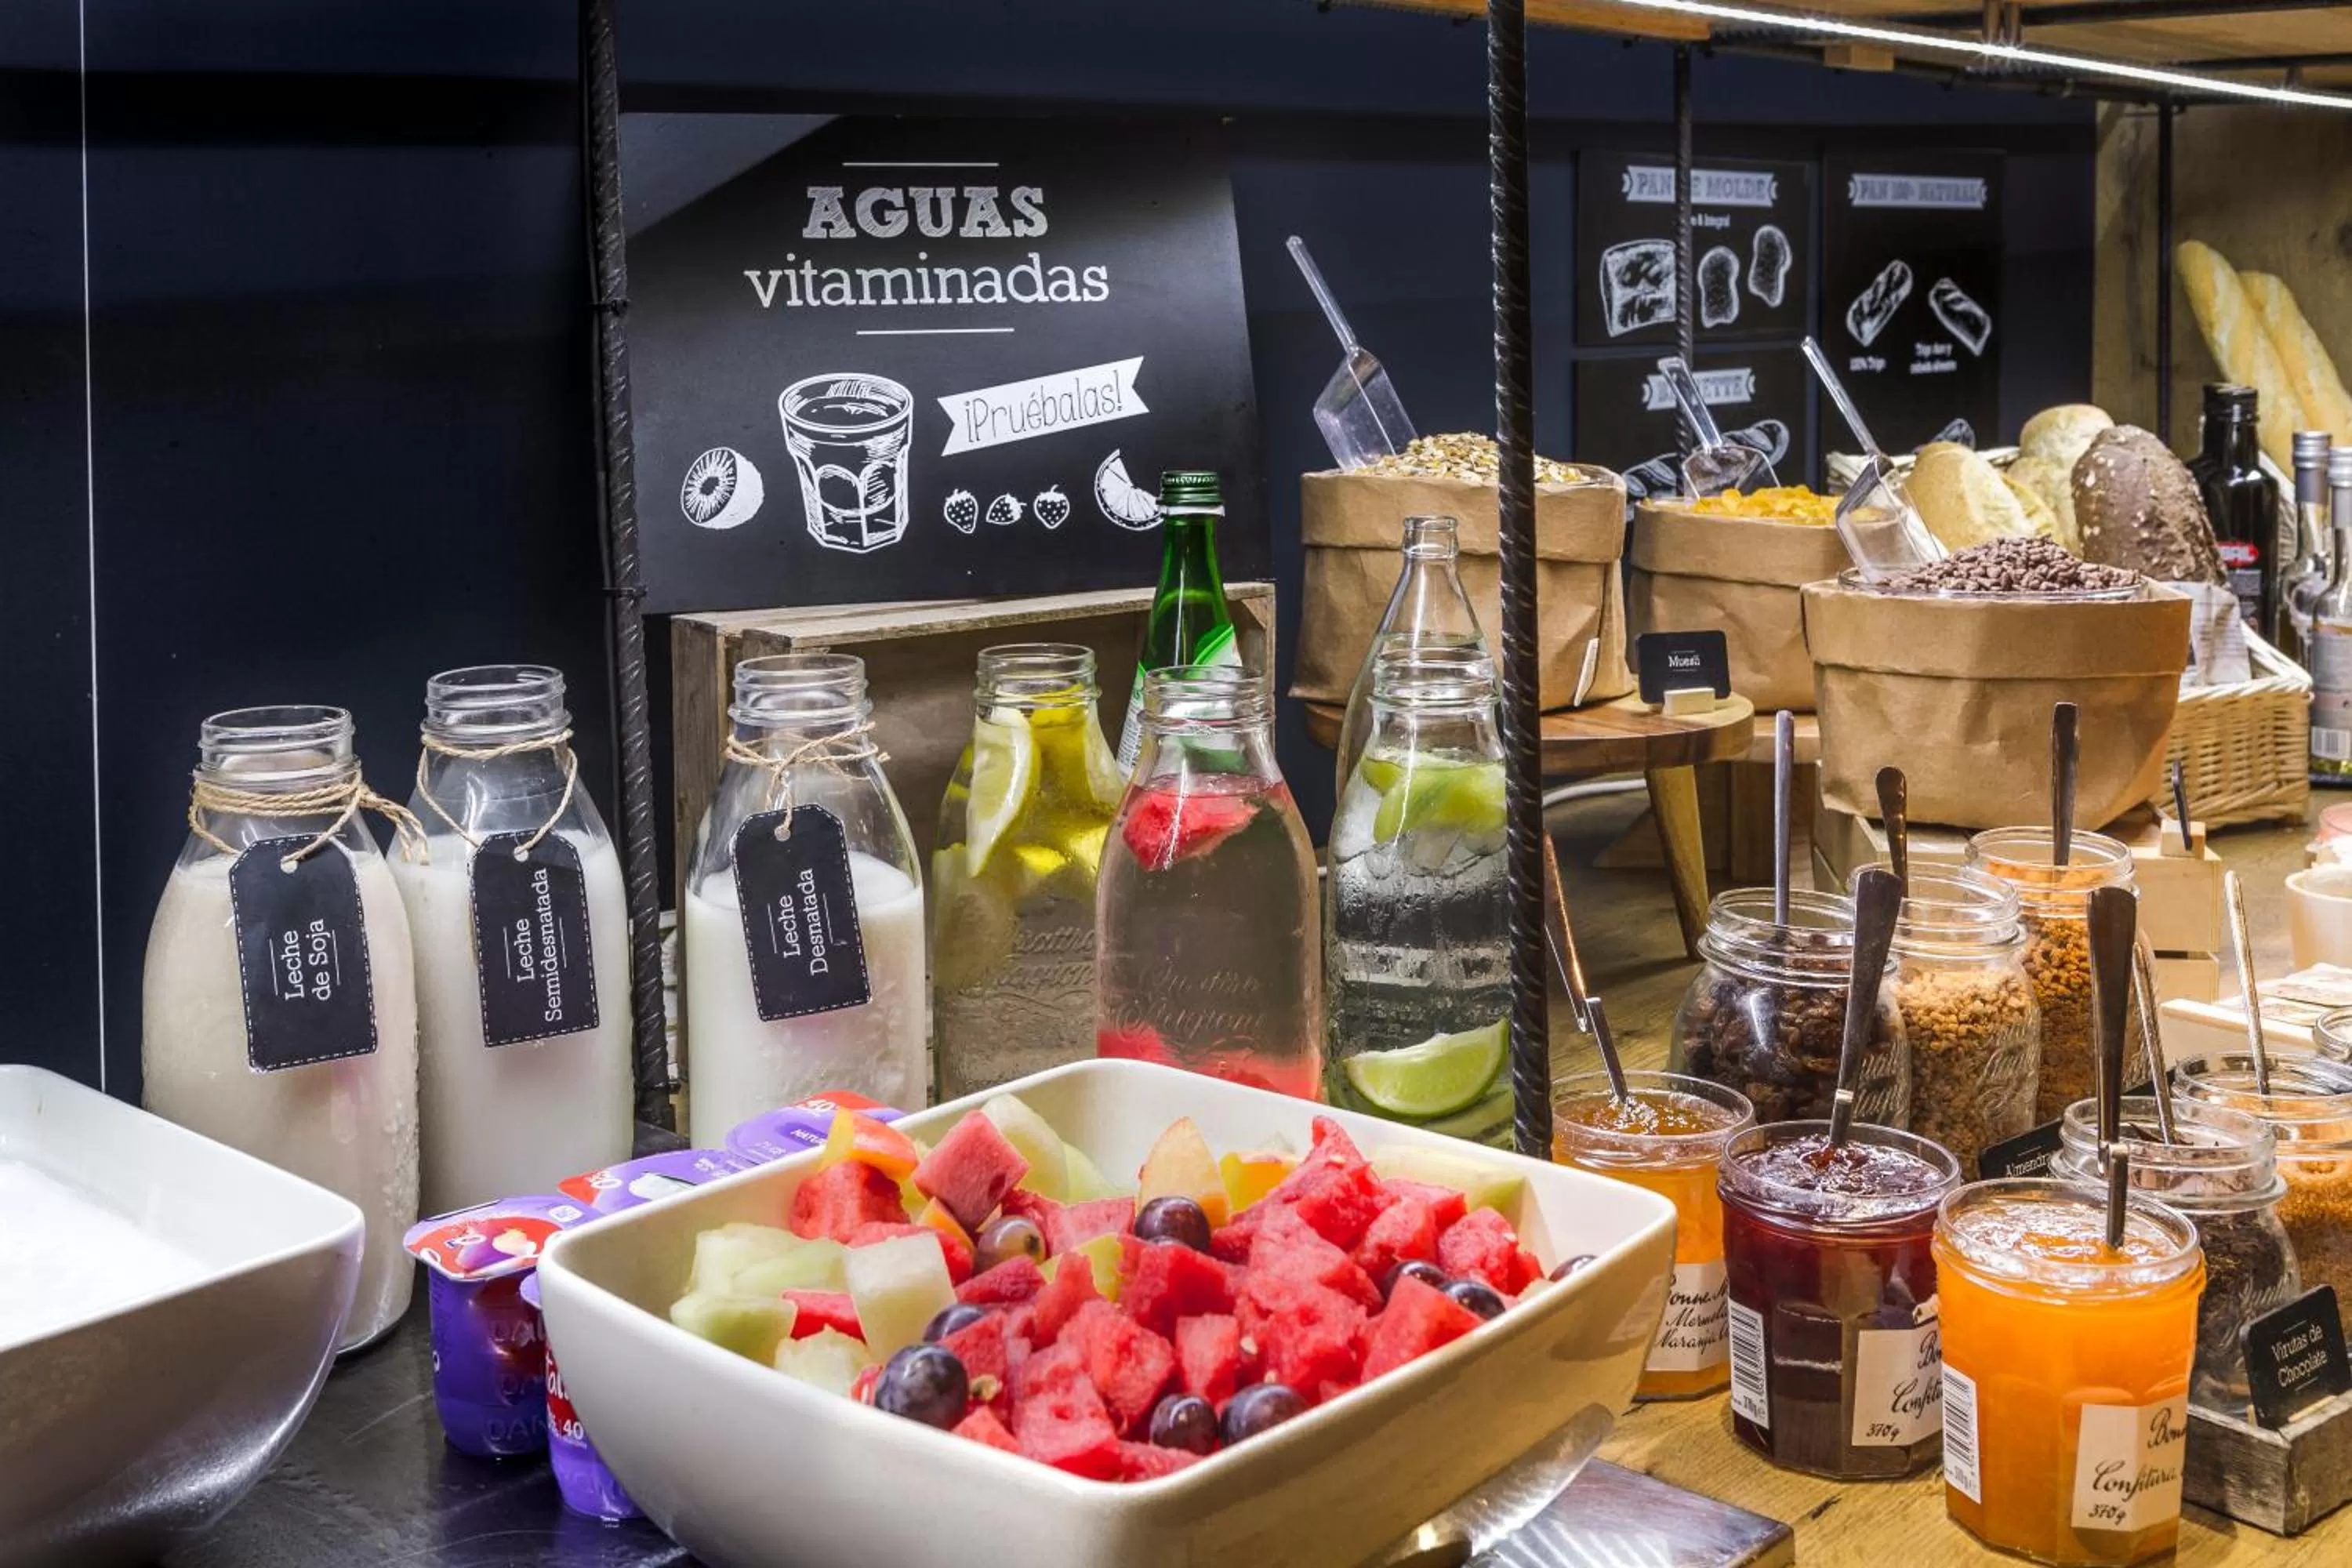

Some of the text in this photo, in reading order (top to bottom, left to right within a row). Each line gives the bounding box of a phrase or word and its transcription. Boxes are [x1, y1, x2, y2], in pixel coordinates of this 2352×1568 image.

[802, 186, 1048, 238] AGUAS
[743, 252, 1111, 309] vitaminadas
[964, 369, 1123, 443] ¡Pruébalas!
[514, 917, 534, 983] Leche
[531, 867, 563, 1022] Semidesnatada
[778, 895, 800, 958] Leche
[797, 867, 829, 976] Desnatada
[281, 930, 305, 1001] Leche
[306, 919, 332, 1002] de Soja
[2271, 1323, 2324, 1363] Virutas de
[2278, 1349, 2328, 1388] Chocolate
[563, 1420, 584, 1440] 40
